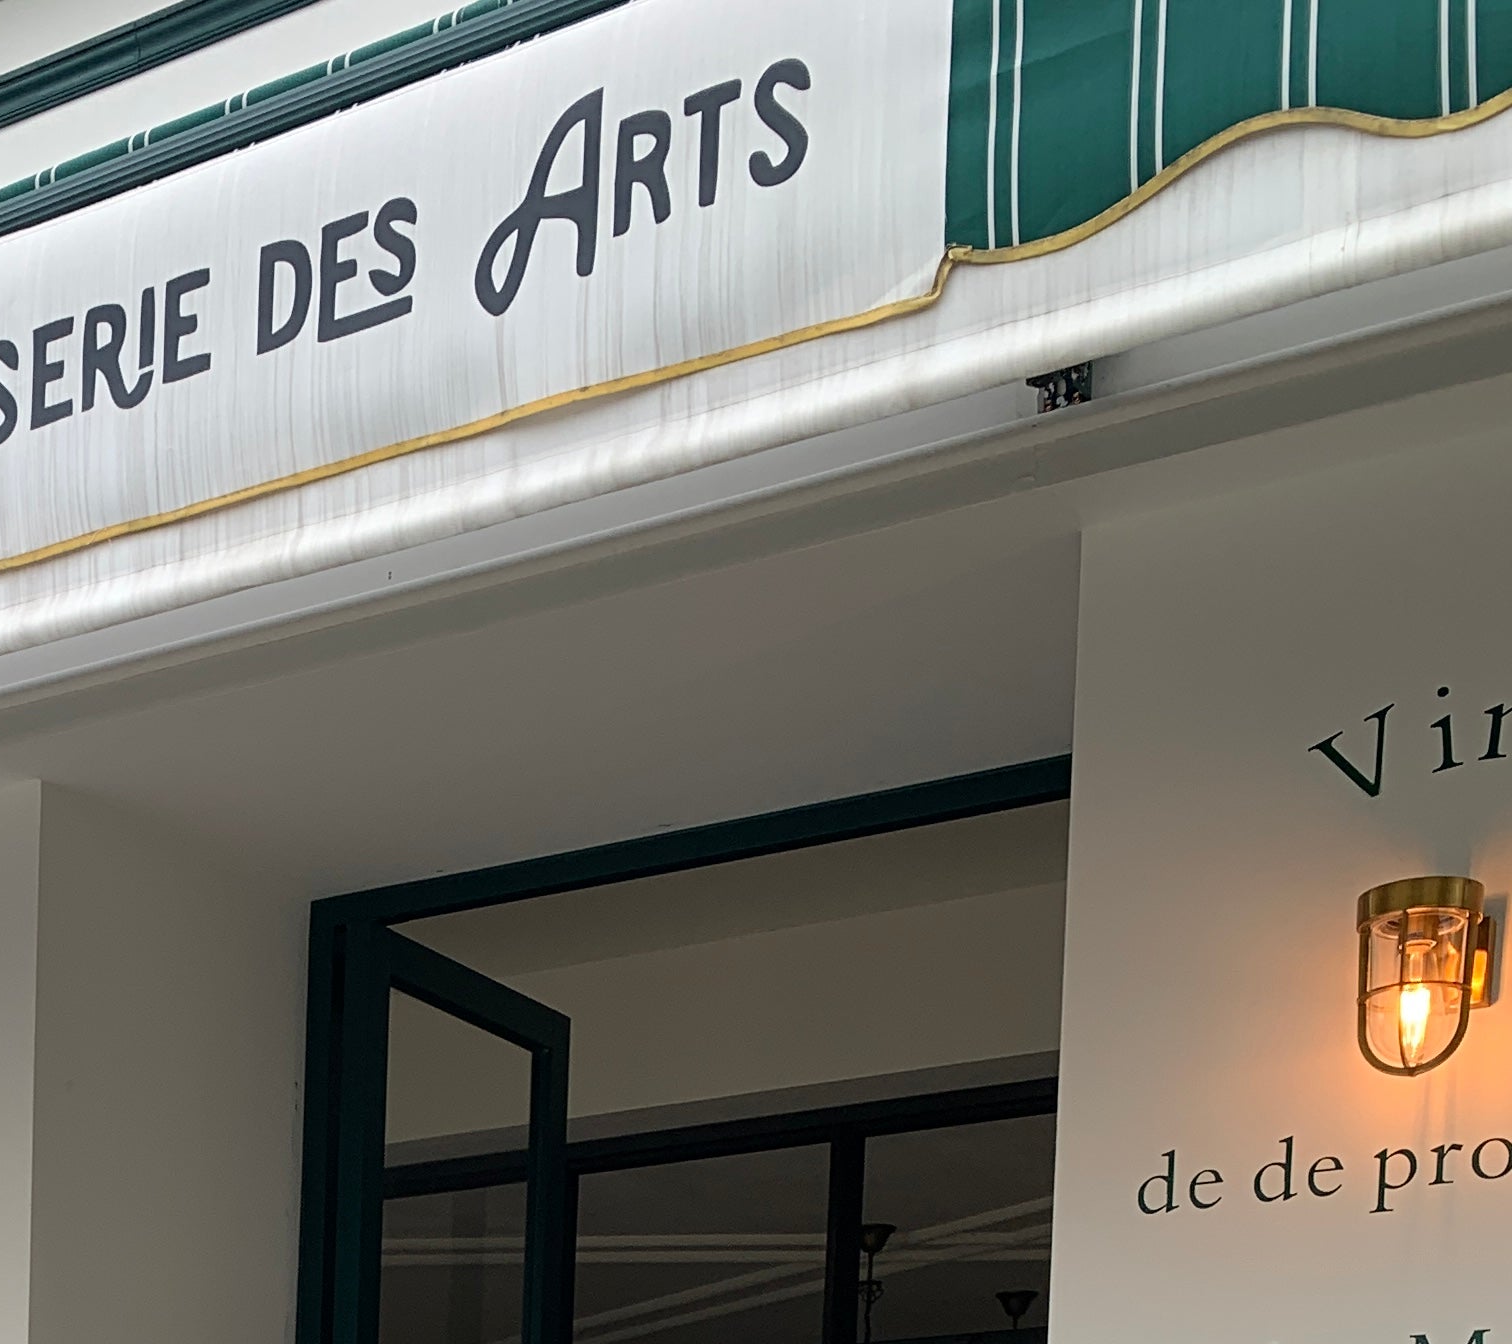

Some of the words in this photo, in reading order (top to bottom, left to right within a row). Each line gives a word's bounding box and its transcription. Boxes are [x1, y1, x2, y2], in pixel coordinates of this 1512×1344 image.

[256, 197, 418, 356] DES
[474, 58, 811, 317] ARTS
[1137, 1149, 1224, 1215] de
[1253, 1135, 1344, 1203] de
